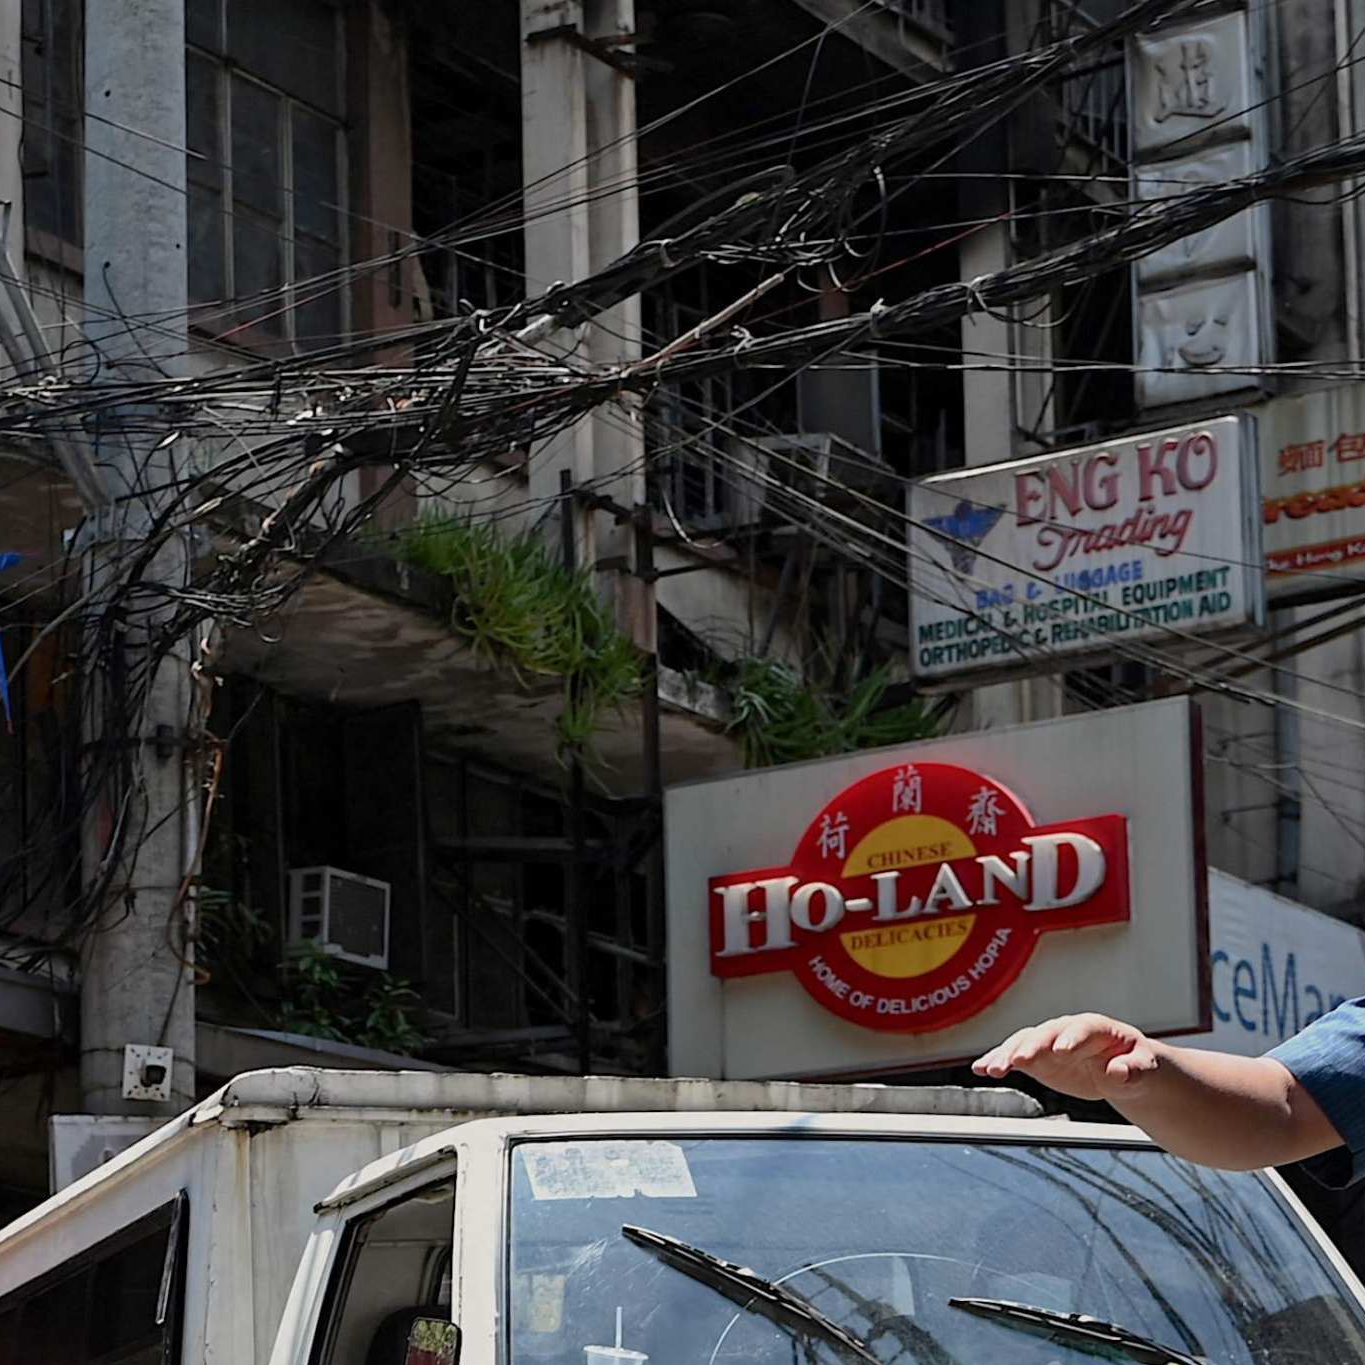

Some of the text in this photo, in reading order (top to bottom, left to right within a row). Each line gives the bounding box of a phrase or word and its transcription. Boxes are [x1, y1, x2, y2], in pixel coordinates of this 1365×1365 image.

[1014, 430, 1218, 528] ENG KO
[1033, 504, 1194, 573] Trading
[1296, 546, 1343, 567] Hong
[919, 628, 1035, 667] ORTHOPEDC
[1199, 590, 1232, 615] AID
[975, 584, 1015, 609] BAG
[1003, 610, 1019, 629] &
[1121, 565, 1232, 606] EQUIPMENT
[866, 840, 953, 869] CHINESE
[714, 832, 1107, 958] HO-LAND
[850, 919, 969, 952] DELICACIES
[807, 926, 1013, 1016] HOME OF DELICIOUS HOPIA
